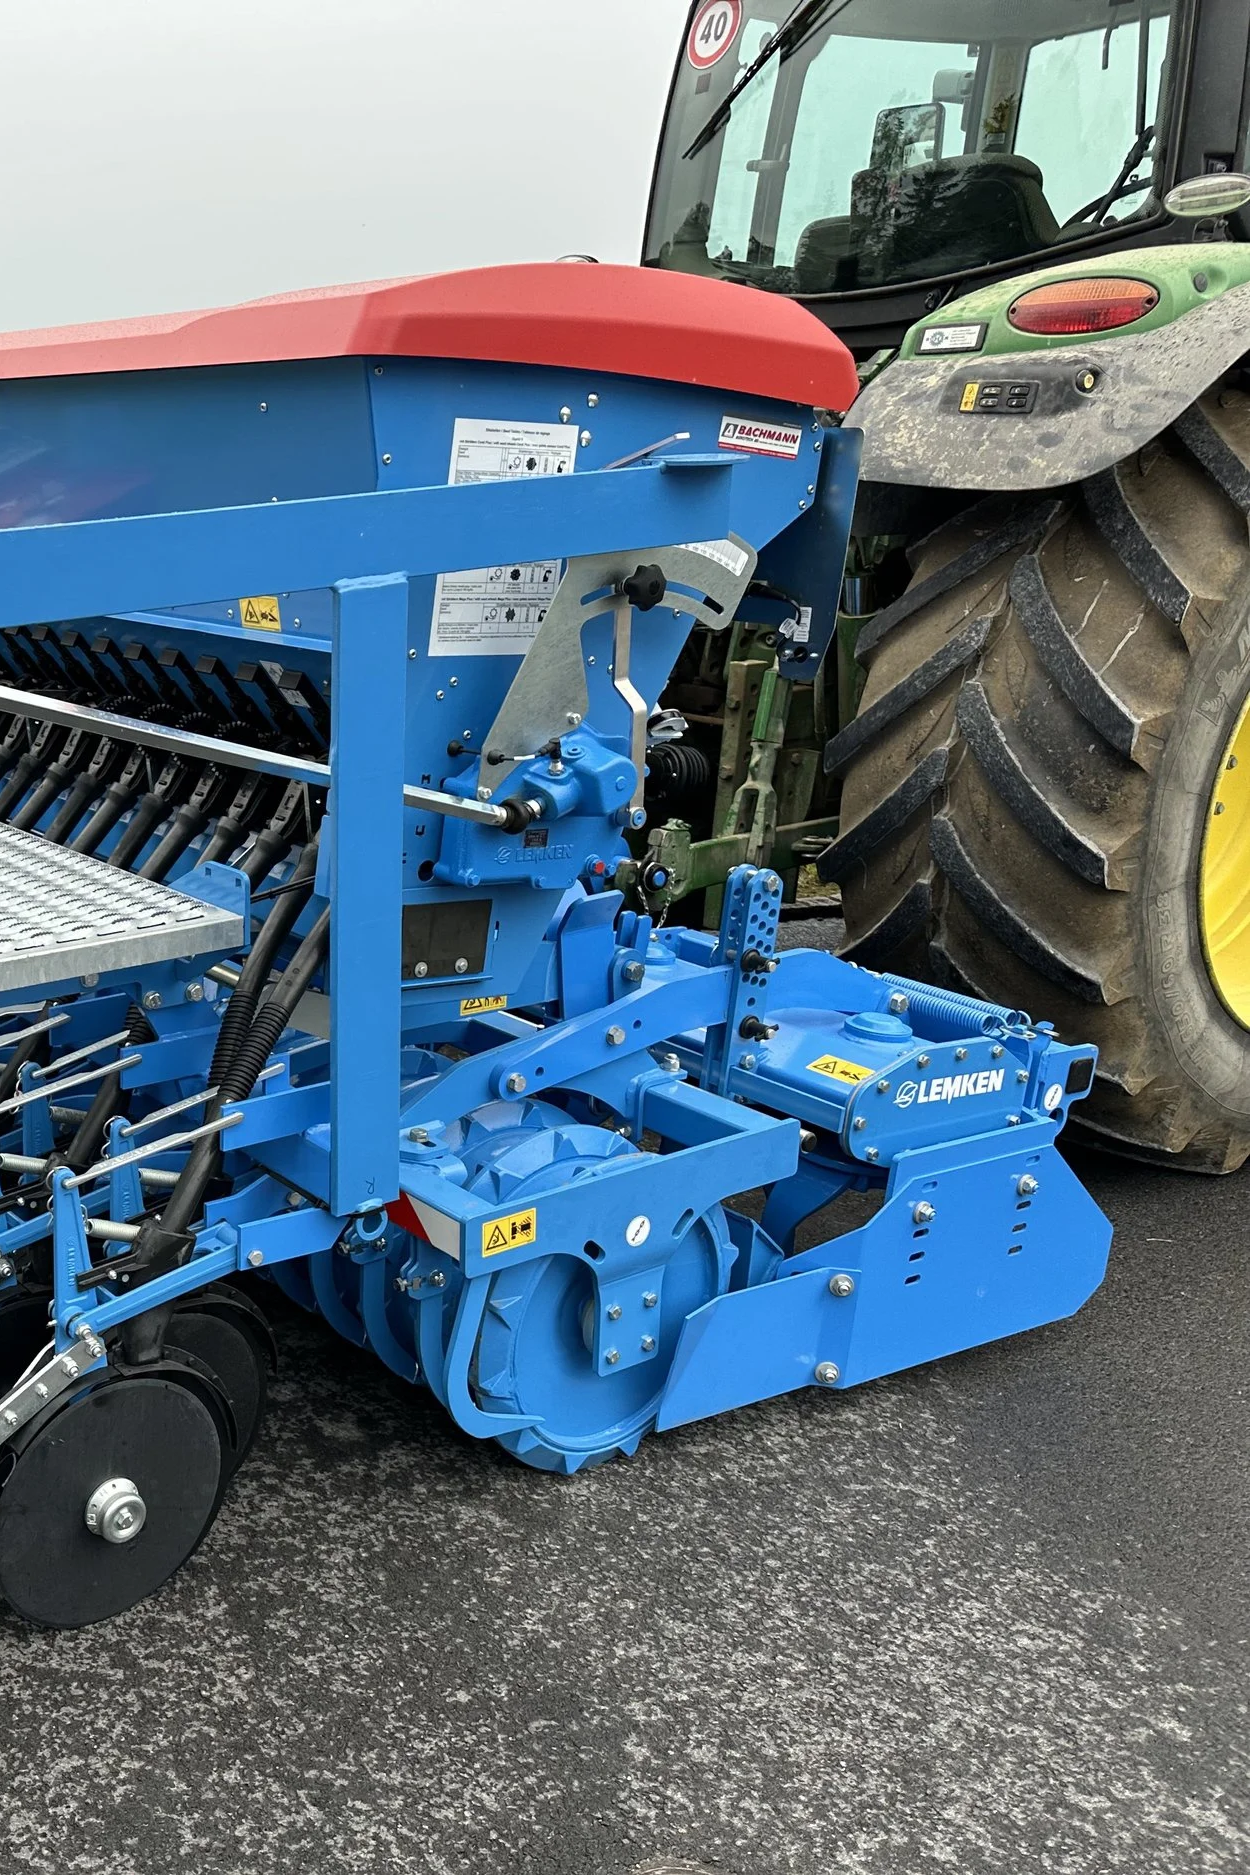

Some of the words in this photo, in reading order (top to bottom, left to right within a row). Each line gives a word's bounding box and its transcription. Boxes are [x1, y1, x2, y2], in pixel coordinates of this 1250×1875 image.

[699, 11, 728, 44] 40
[738, 425, 799, 445] BACHMANN
[1156, 890, 1172, 928] 38
[1159, 933, 1175, 954] R
[1160, 956, 1194, 1045] 650/60
[917, 1068, 1005, 1105] LEMKEN
